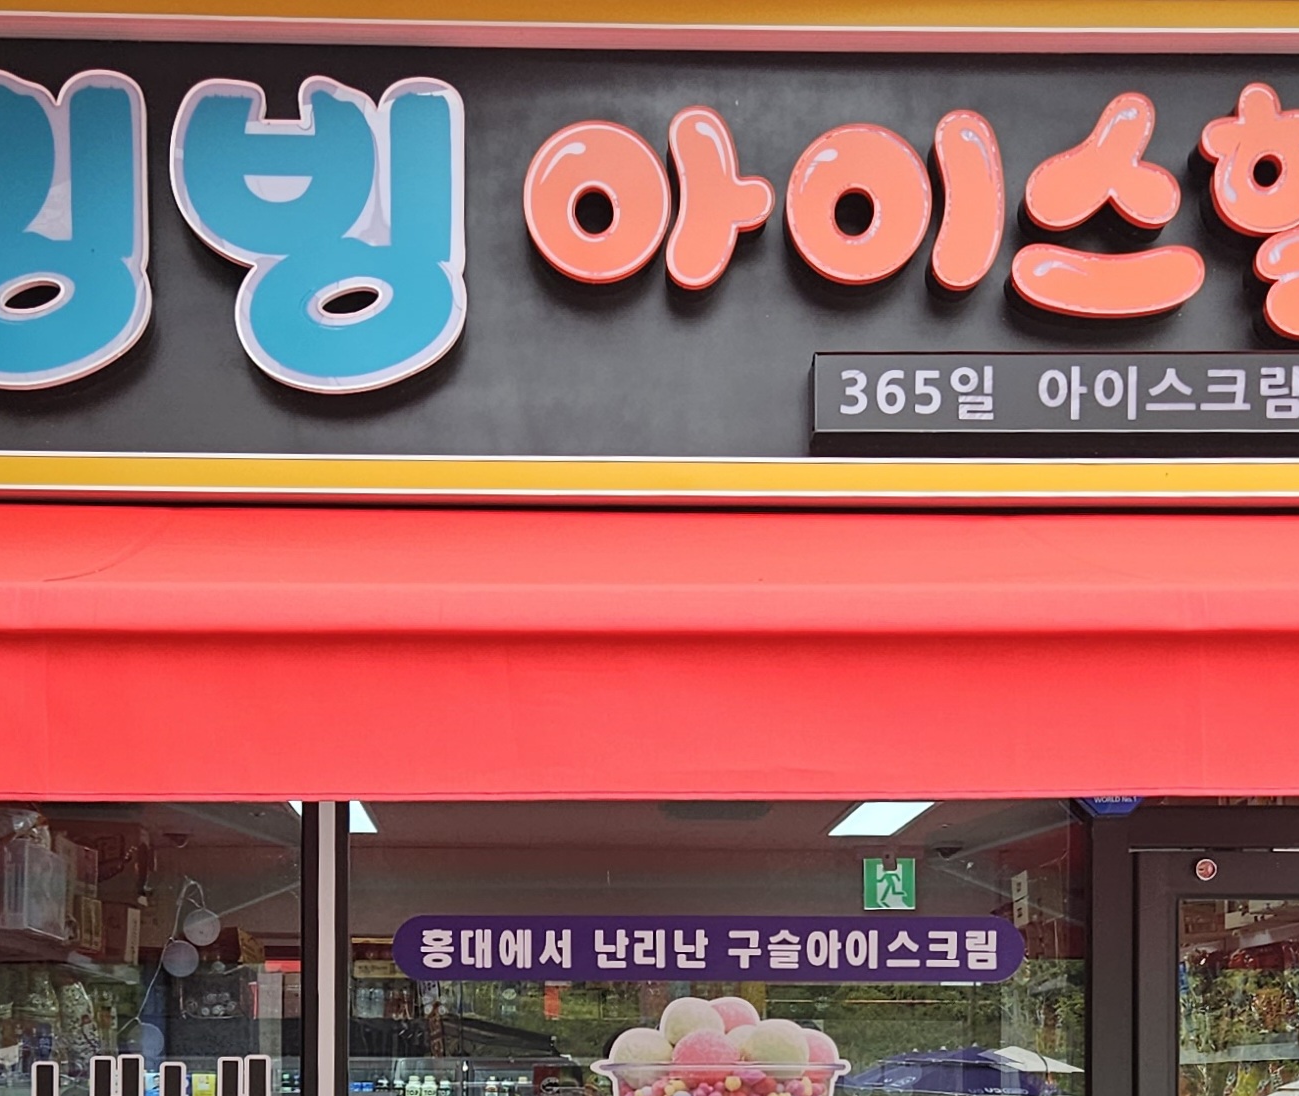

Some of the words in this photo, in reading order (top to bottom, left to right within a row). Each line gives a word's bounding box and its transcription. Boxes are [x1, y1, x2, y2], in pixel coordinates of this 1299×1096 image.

[838, 364, 996, 422] 365일
[420, 927, 573, 970] 홍대에서
[594, 928, 710, 970] 난리난
[727, 928, 999, 970] 구슬아이스크림
